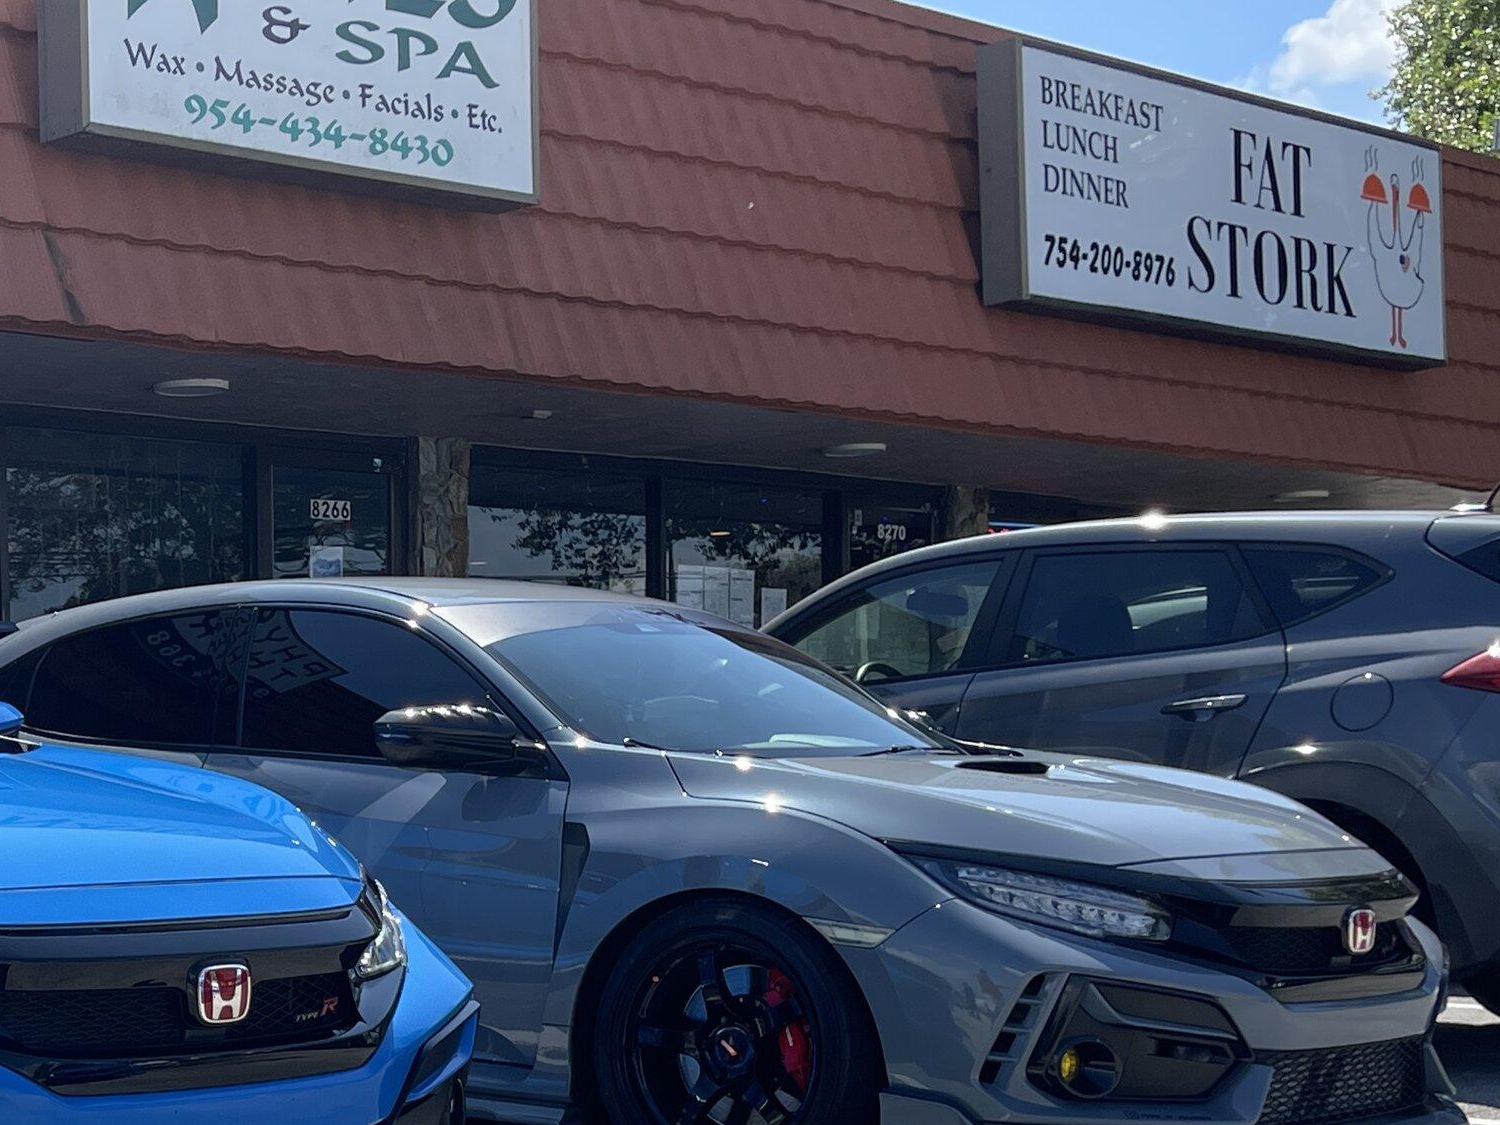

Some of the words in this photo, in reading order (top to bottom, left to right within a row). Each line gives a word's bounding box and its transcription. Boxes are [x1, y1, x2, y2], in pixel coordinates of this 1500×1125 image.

[261, 5, 311, 45] &
[334, 19, 500, 89] SPA
[122, 37, 187, 77] Wax
[213, 55, 335, 107] Massage
[358, 83, 444, 122] Facials
[467, 104, 503, 133] Etc.
[1040, 76, 1164, 132] BREAKFAST
[184, 94, 455, 167] 954-434-8430
[1041, 120, 1119, 163] LUNCH
[1043, 163, 1129, 208] DINNER
[1230, 128, 1311, 218] FAT
[1044, 234, 1176, 288] 754-200-8976
[1188, 216, 1357, 319] STORK
[312, 501, 349, 519] 8266
[877, 523, 907, 541] 8270
[294, 1010, 319, 1023] TYPE
[320, 996, 339, 1018] R
